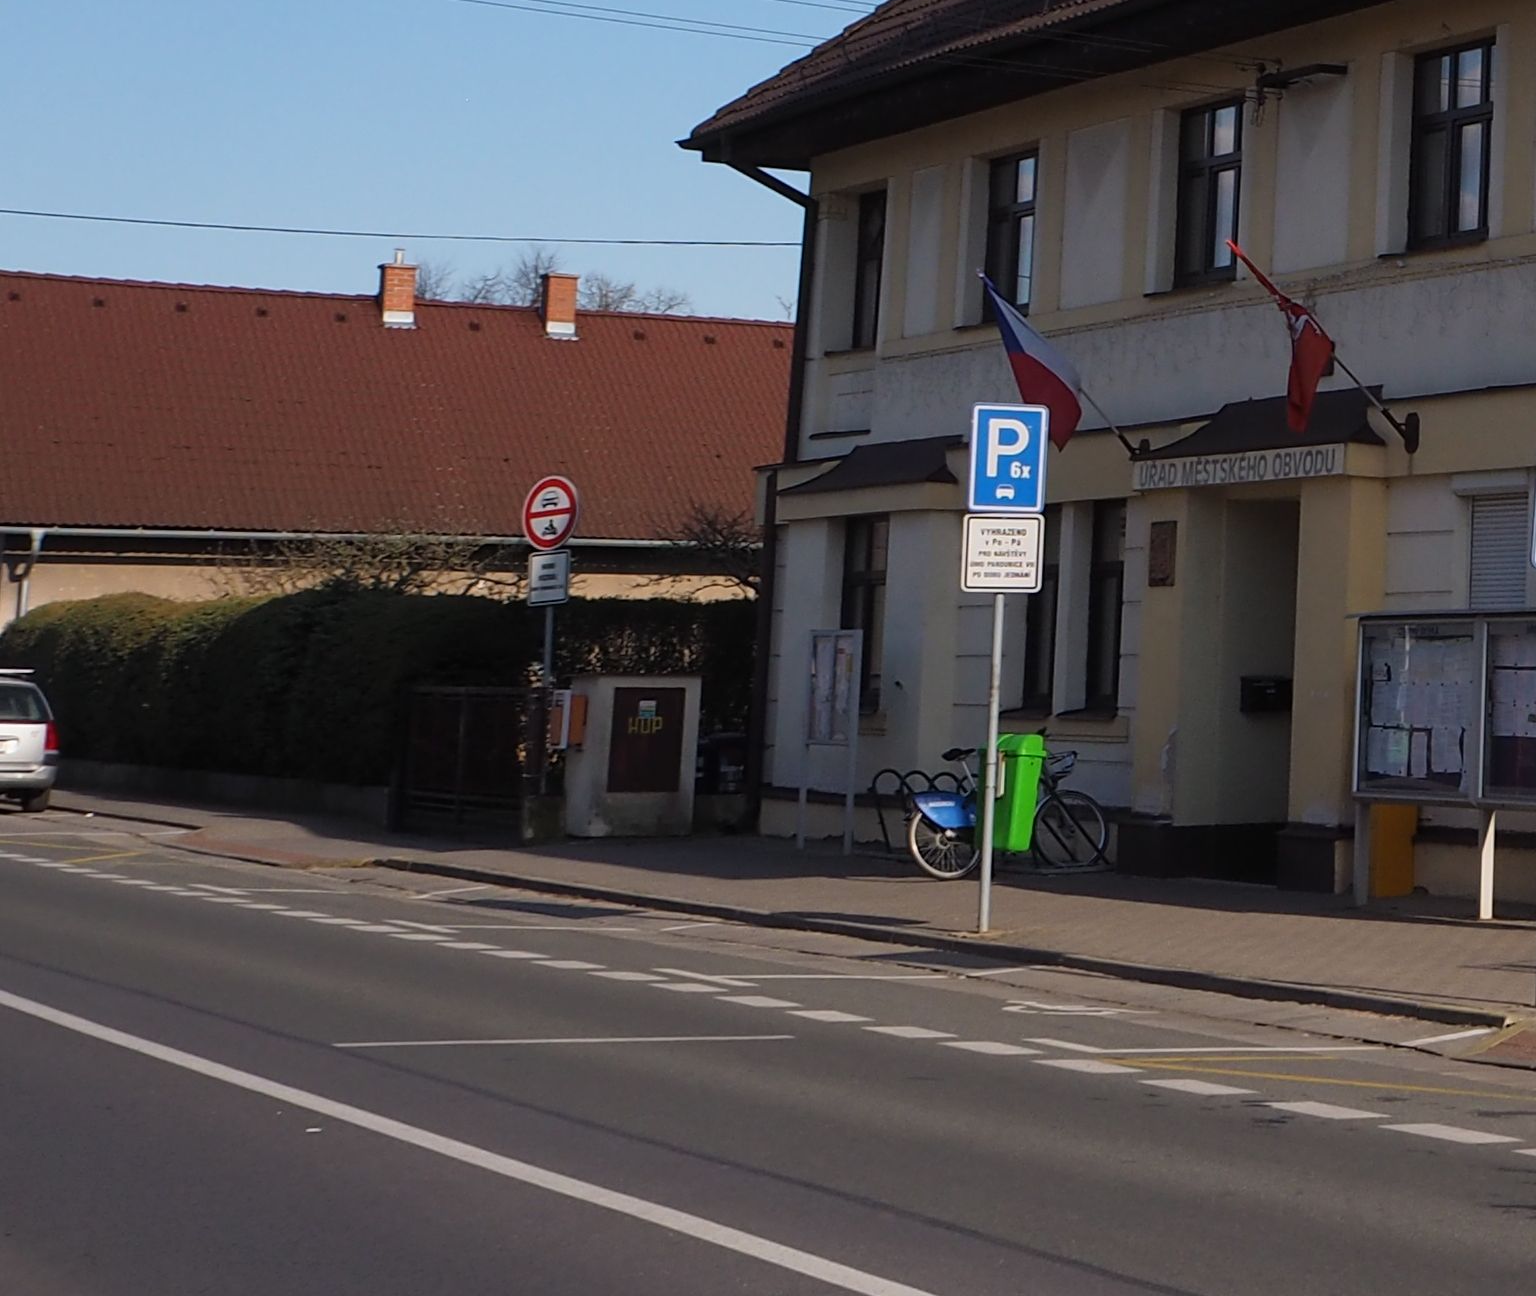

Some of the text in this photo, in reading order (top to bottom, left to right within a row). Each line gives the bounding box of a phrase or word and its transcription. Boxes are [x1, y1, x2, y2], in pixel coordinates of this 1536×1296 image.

[985, 417, 1030, 478] P
[1010, 461, 1031, 479] 6x
[1139, 448, 1335, 487] ÚŘAD MĚSTSKÉHO OBVODU
[980, 528, 1027, 537] VYHRAZENO
[628, 715, 663, 734] HUP
